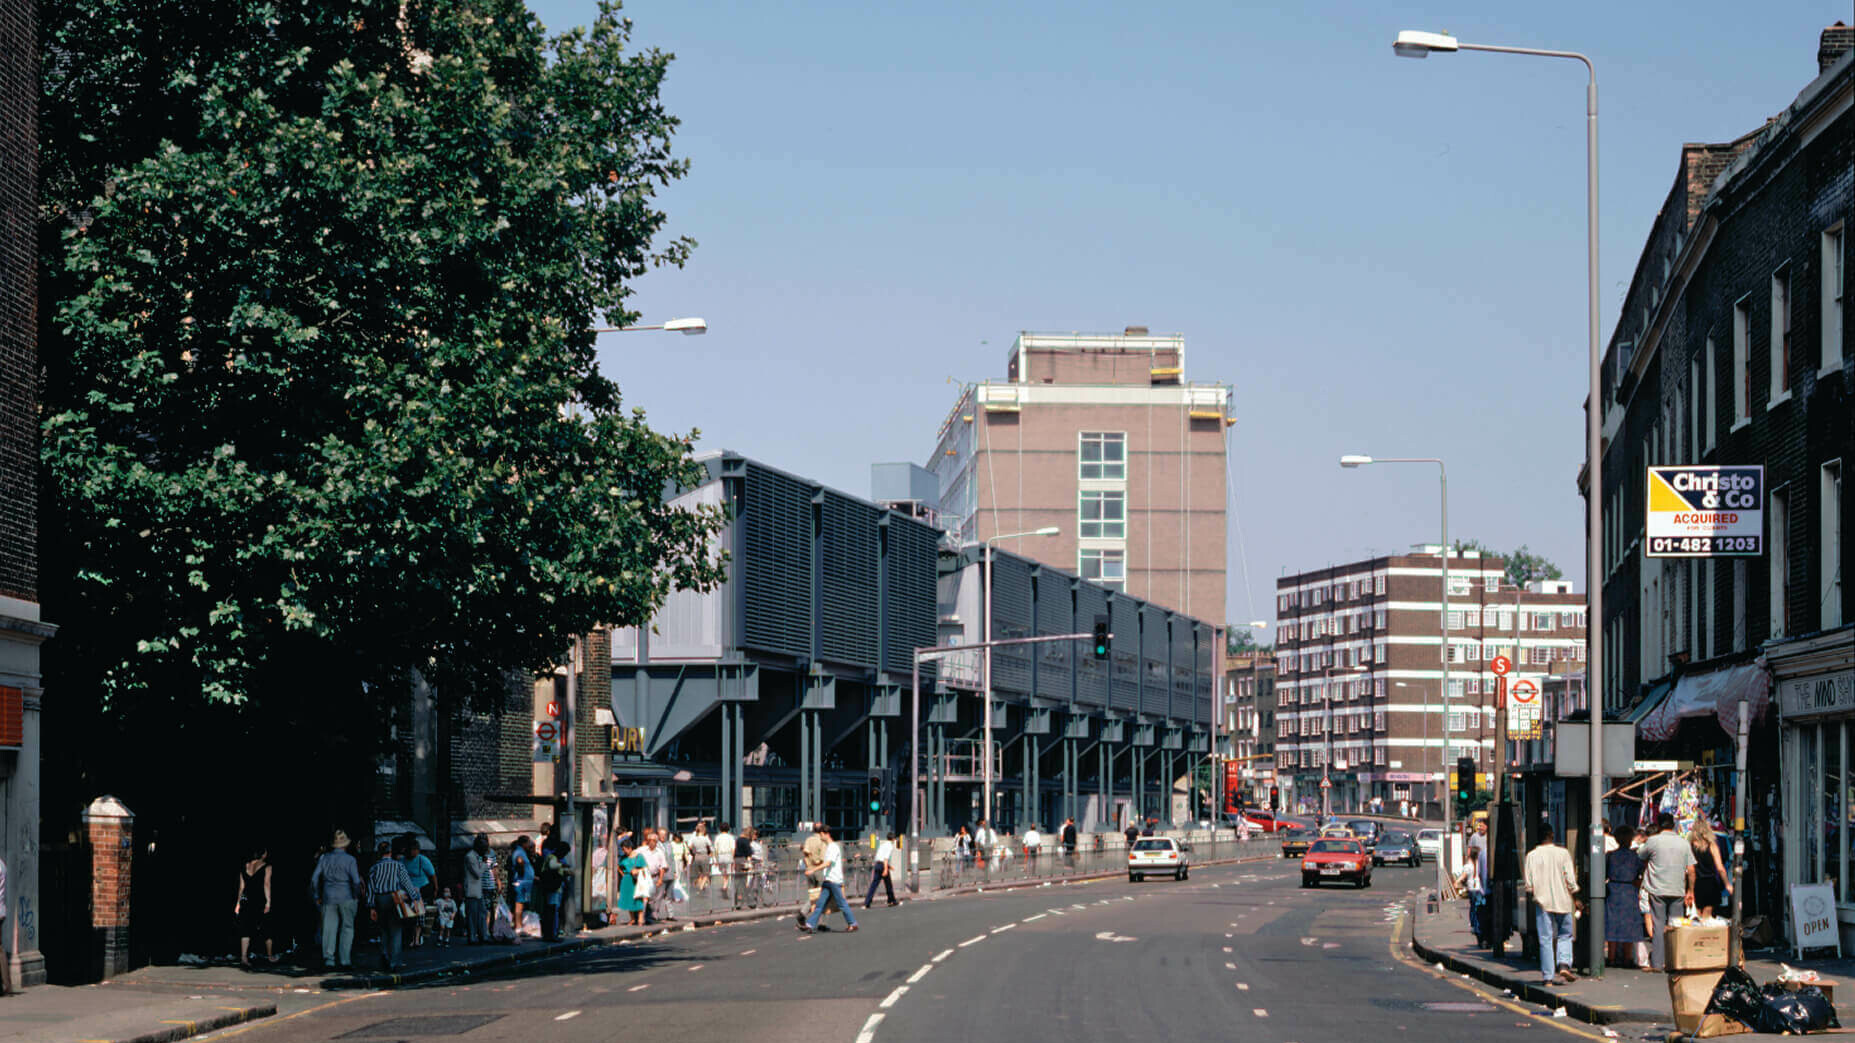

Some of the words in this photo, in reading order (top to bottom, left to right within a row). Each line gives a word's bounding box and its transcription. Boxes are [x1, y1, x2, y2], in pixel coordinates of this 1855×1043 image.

[1673, 472, 1755, 491] Christo
[1702, 490, 1721, 508] &
[1725, 491, 1754, 508] Co
[1673, 513, 1739, 525] ACQUIRED
[1654, 538, 1712, 552] 01-482
[1716, 538, 1756, 551] 1203
[1495, 659, 1506, 673] S
[548, 703, 559, 715] N
[1803, 917, 1829, 936] OPEN
